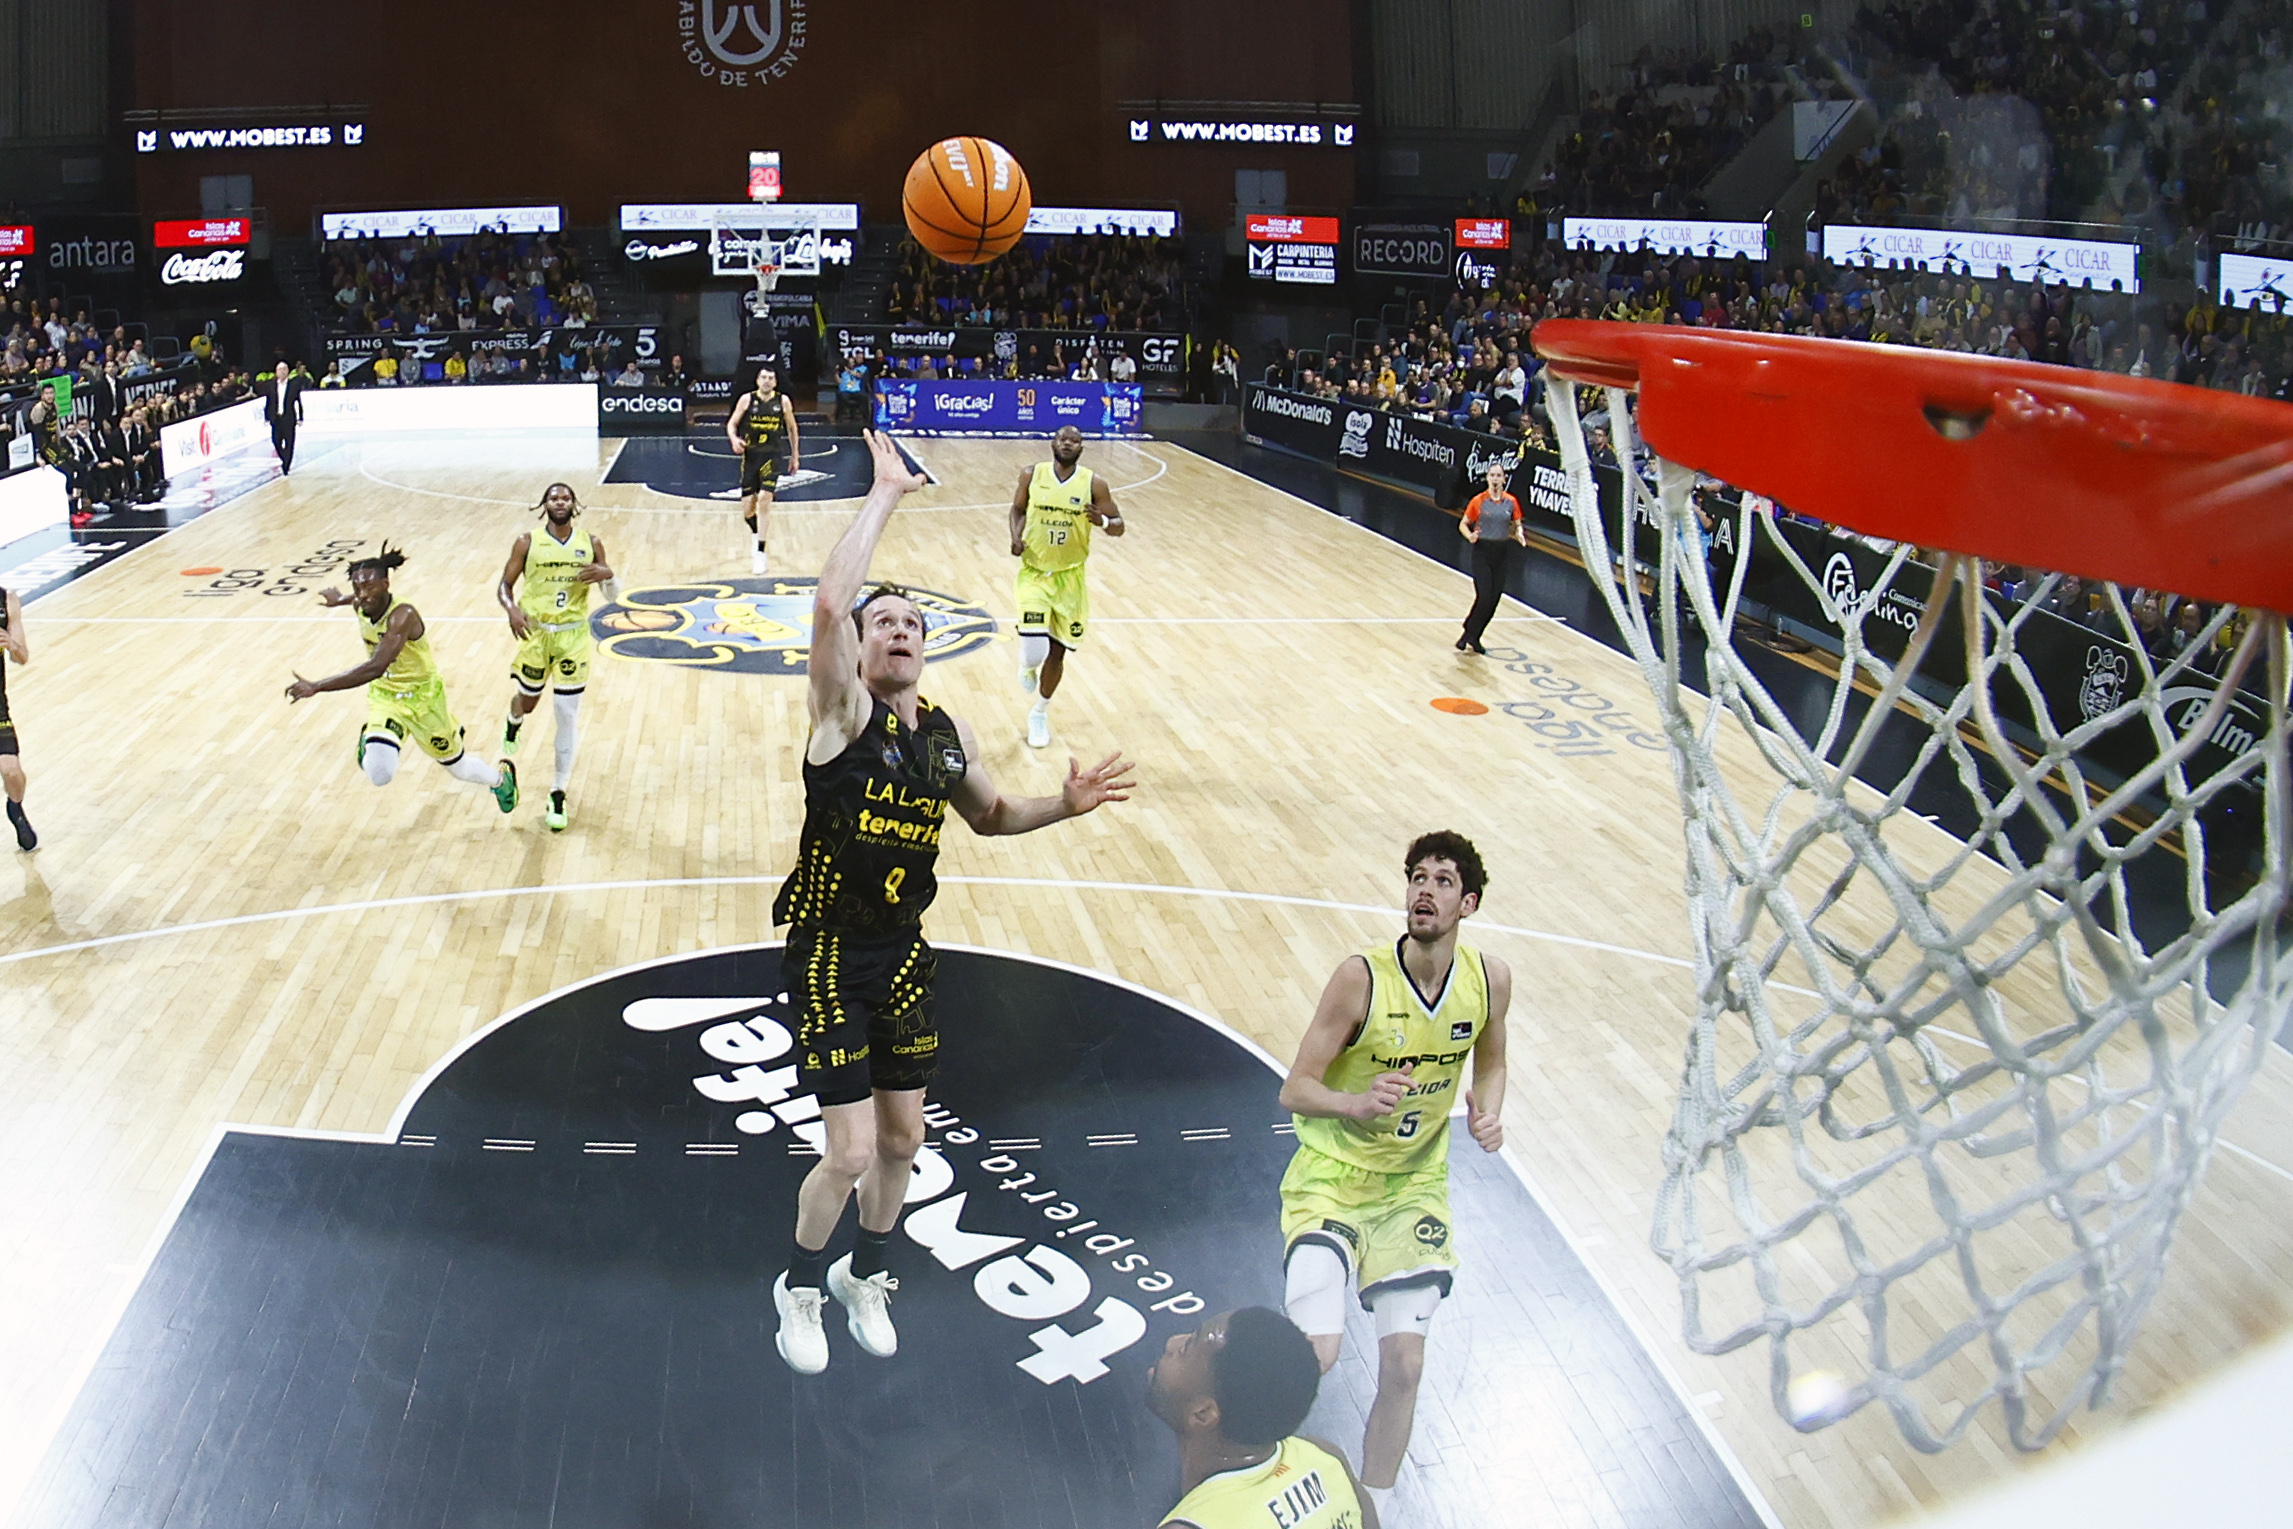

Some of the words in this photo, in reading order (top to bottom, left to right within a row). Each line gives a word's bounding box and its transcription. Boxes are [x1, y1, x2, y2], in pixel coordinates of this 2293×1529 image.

[719, 69, 748, 87] DE
[169, 126, 332, 150] WWW.MOBEST.ES
[1161, 121, 1321, 144] WWW.MOBEST.ES
[750, 167, 780, 186] 20
[363, 215, 399, 227] CICAR
[441, 213, 477, 225] CICAR
[519, 211, 555, 222] CICAR
[661, 208, 697, 219] CICAR
[1051, 212, 1088, 225] CICAR
[1129, 213, 1165, 227] CICAR
[1595, 223, 1627, 240] CICAR
[1660, 225, 1693, 242] CICAR
[1729, 228, 1764, 246] CICAR
[49, 235, 135, 269] antara
[1276, 244, 1335, 259] CARPINTERIA
[1361, 239, 1444, 264] RECORD
[1883, 234, 1923, 254] CICAR
[1970, 240, 2014, 261] CICAR
[2065, 248, 2112, 271] CICAR
[326, 338, 383, 350] SPRING
[635, 328, 657, 357] 5
[1142, 338, 1179, 363] GF
[601, 393, 682, 413] endesa
[1017, 388, 1036, 406] 50
[1266, 395, 1332, 426] McDonald's
[1402, 433, 1455, 466] Hospiten
[1048, 530, 1067, 546] 12
[555, 591, 567, 608] 2
[1493, 702, 1617, 757] liga
[865, 777, 894, 804] LA
[1396, 1110, 1422, 1138] 5
[979, 1153, 1206, 1316] despierta
[1416, 1223, 1446, 1240] Q2
[1267, 1471, 1328, 1529] EJIM
